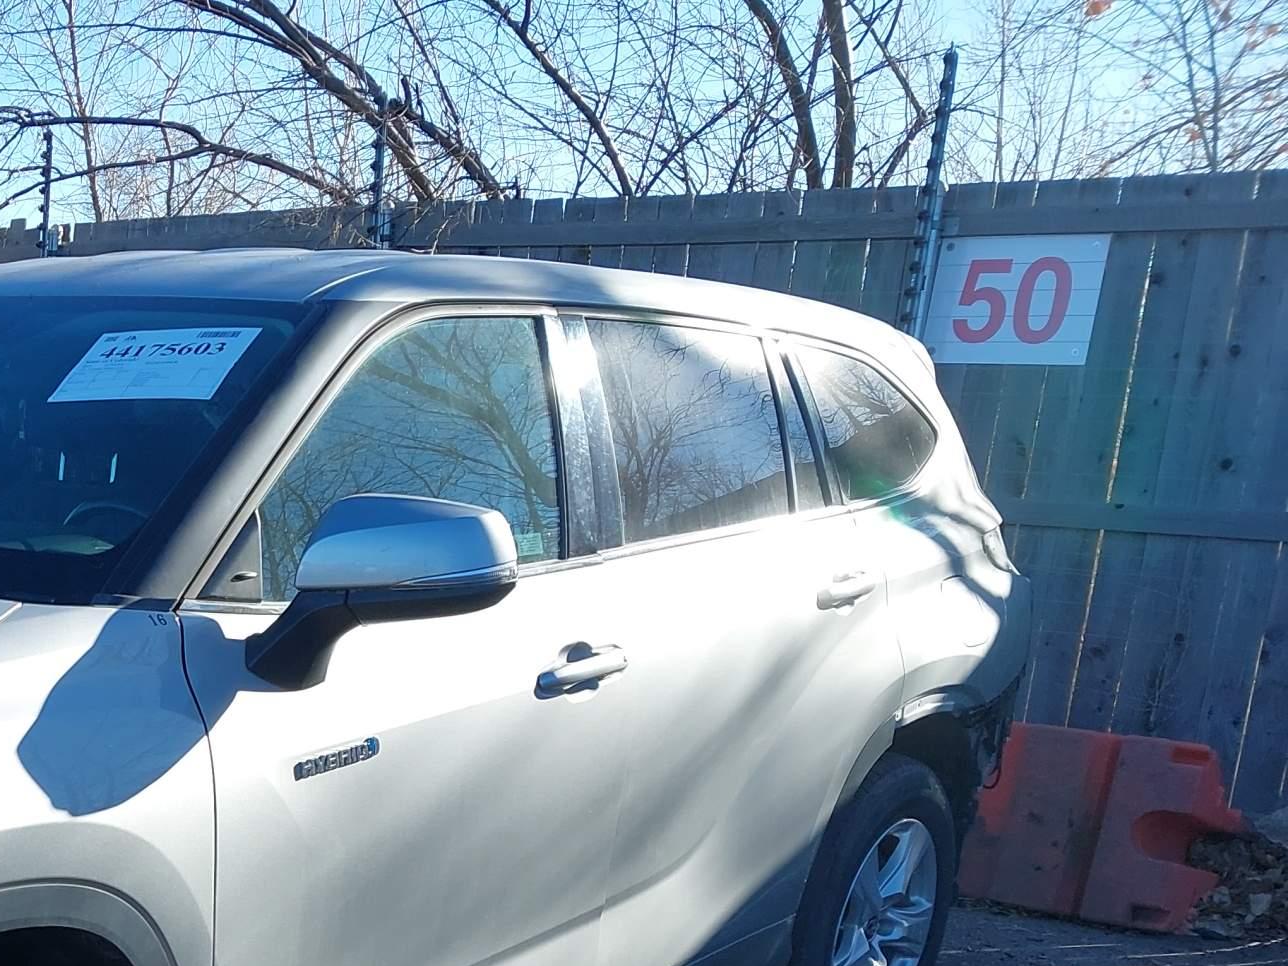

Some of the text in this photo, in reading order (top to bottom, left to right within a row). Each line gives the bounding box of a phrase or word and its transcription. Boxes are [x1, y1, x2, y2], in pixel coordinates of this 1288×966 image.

[952, 257, 1072, 344] 50
[99, 342, 227, 359] 44175603
[148, 613, 167, 626] 16
